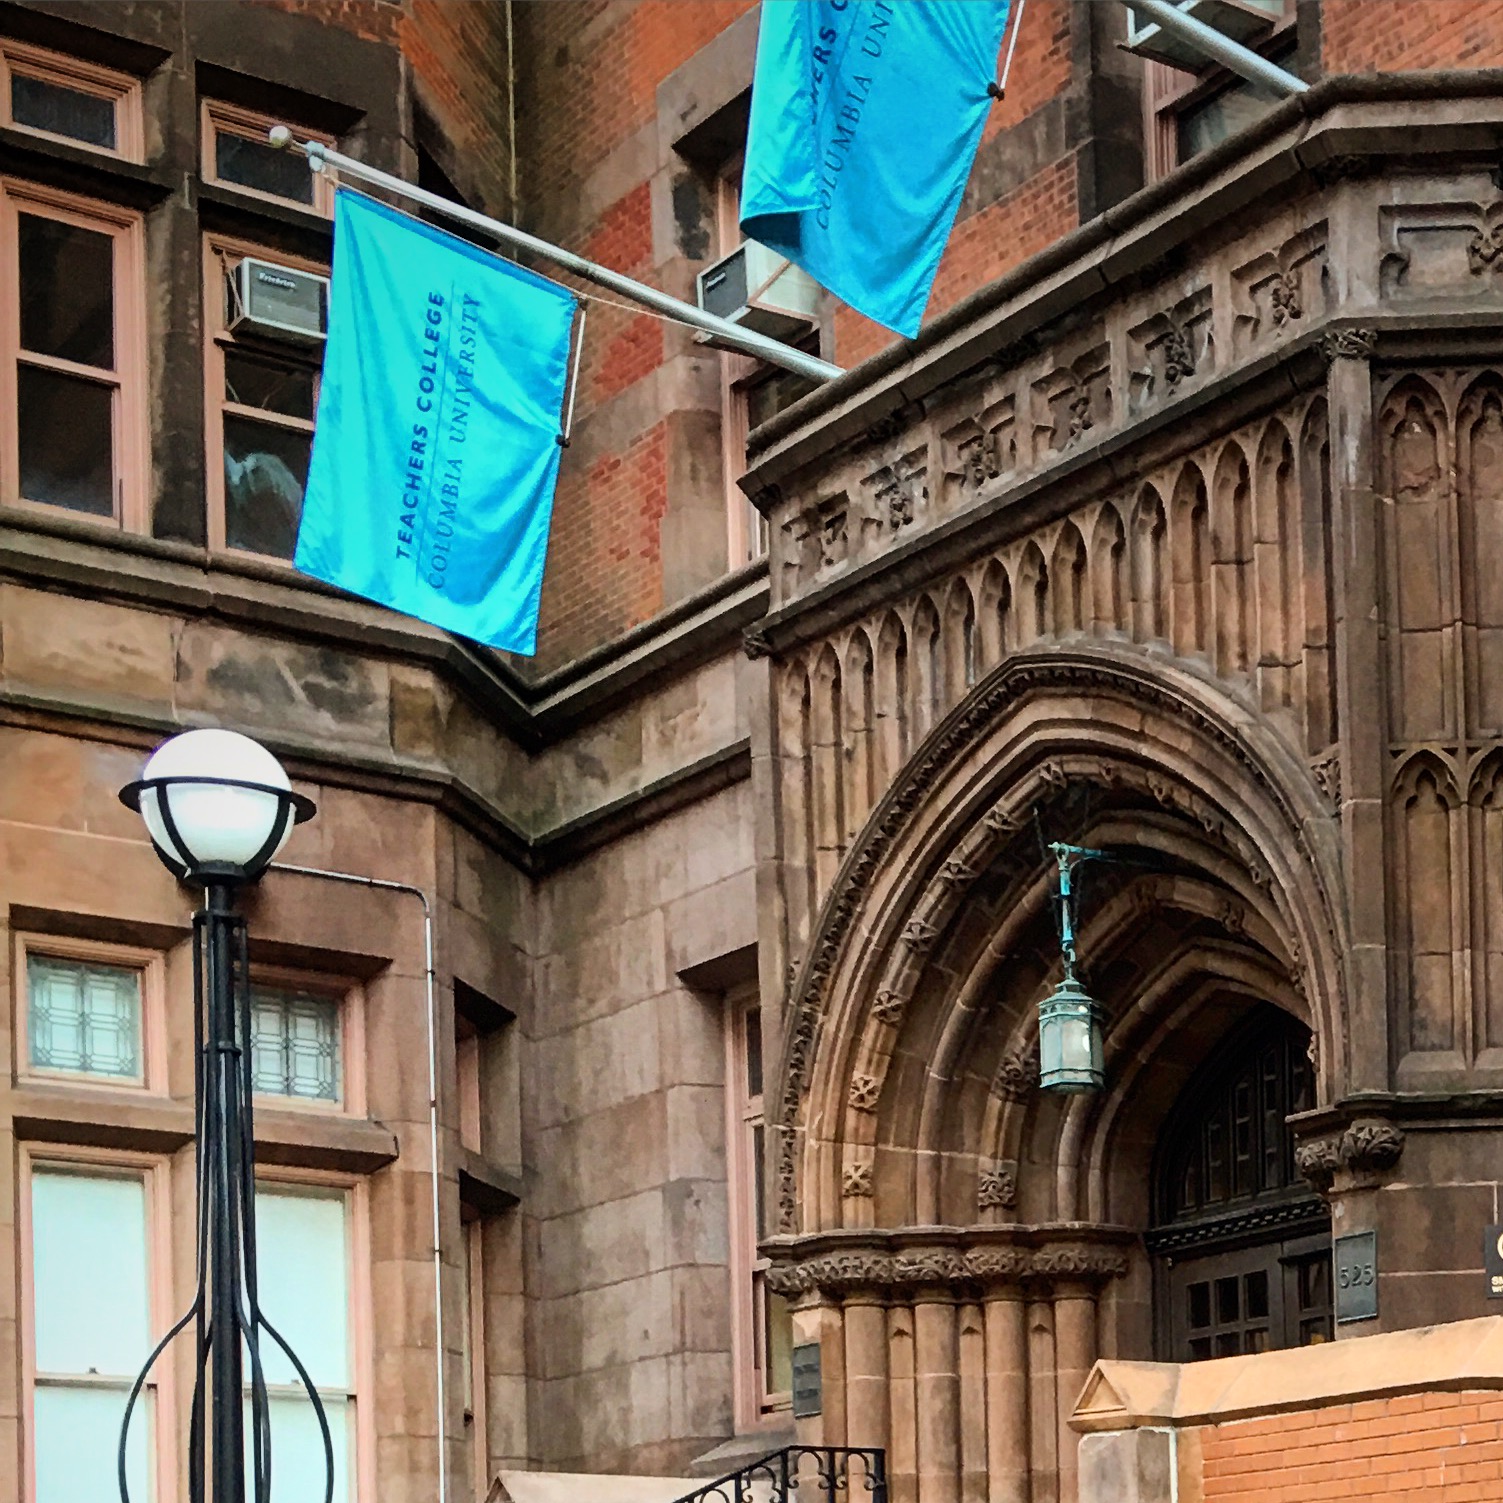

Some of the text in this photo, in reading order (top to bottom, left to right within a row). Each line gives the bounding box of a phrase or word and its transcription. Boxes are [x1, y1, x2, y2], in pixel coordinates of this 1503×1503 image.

[396, 291, 445, 560] TEACHERS COLLEGE
[427, 293, 481, 590] COLUMBIA UNIVERSITY
[1340, 1263, 1374, 1289] 525
